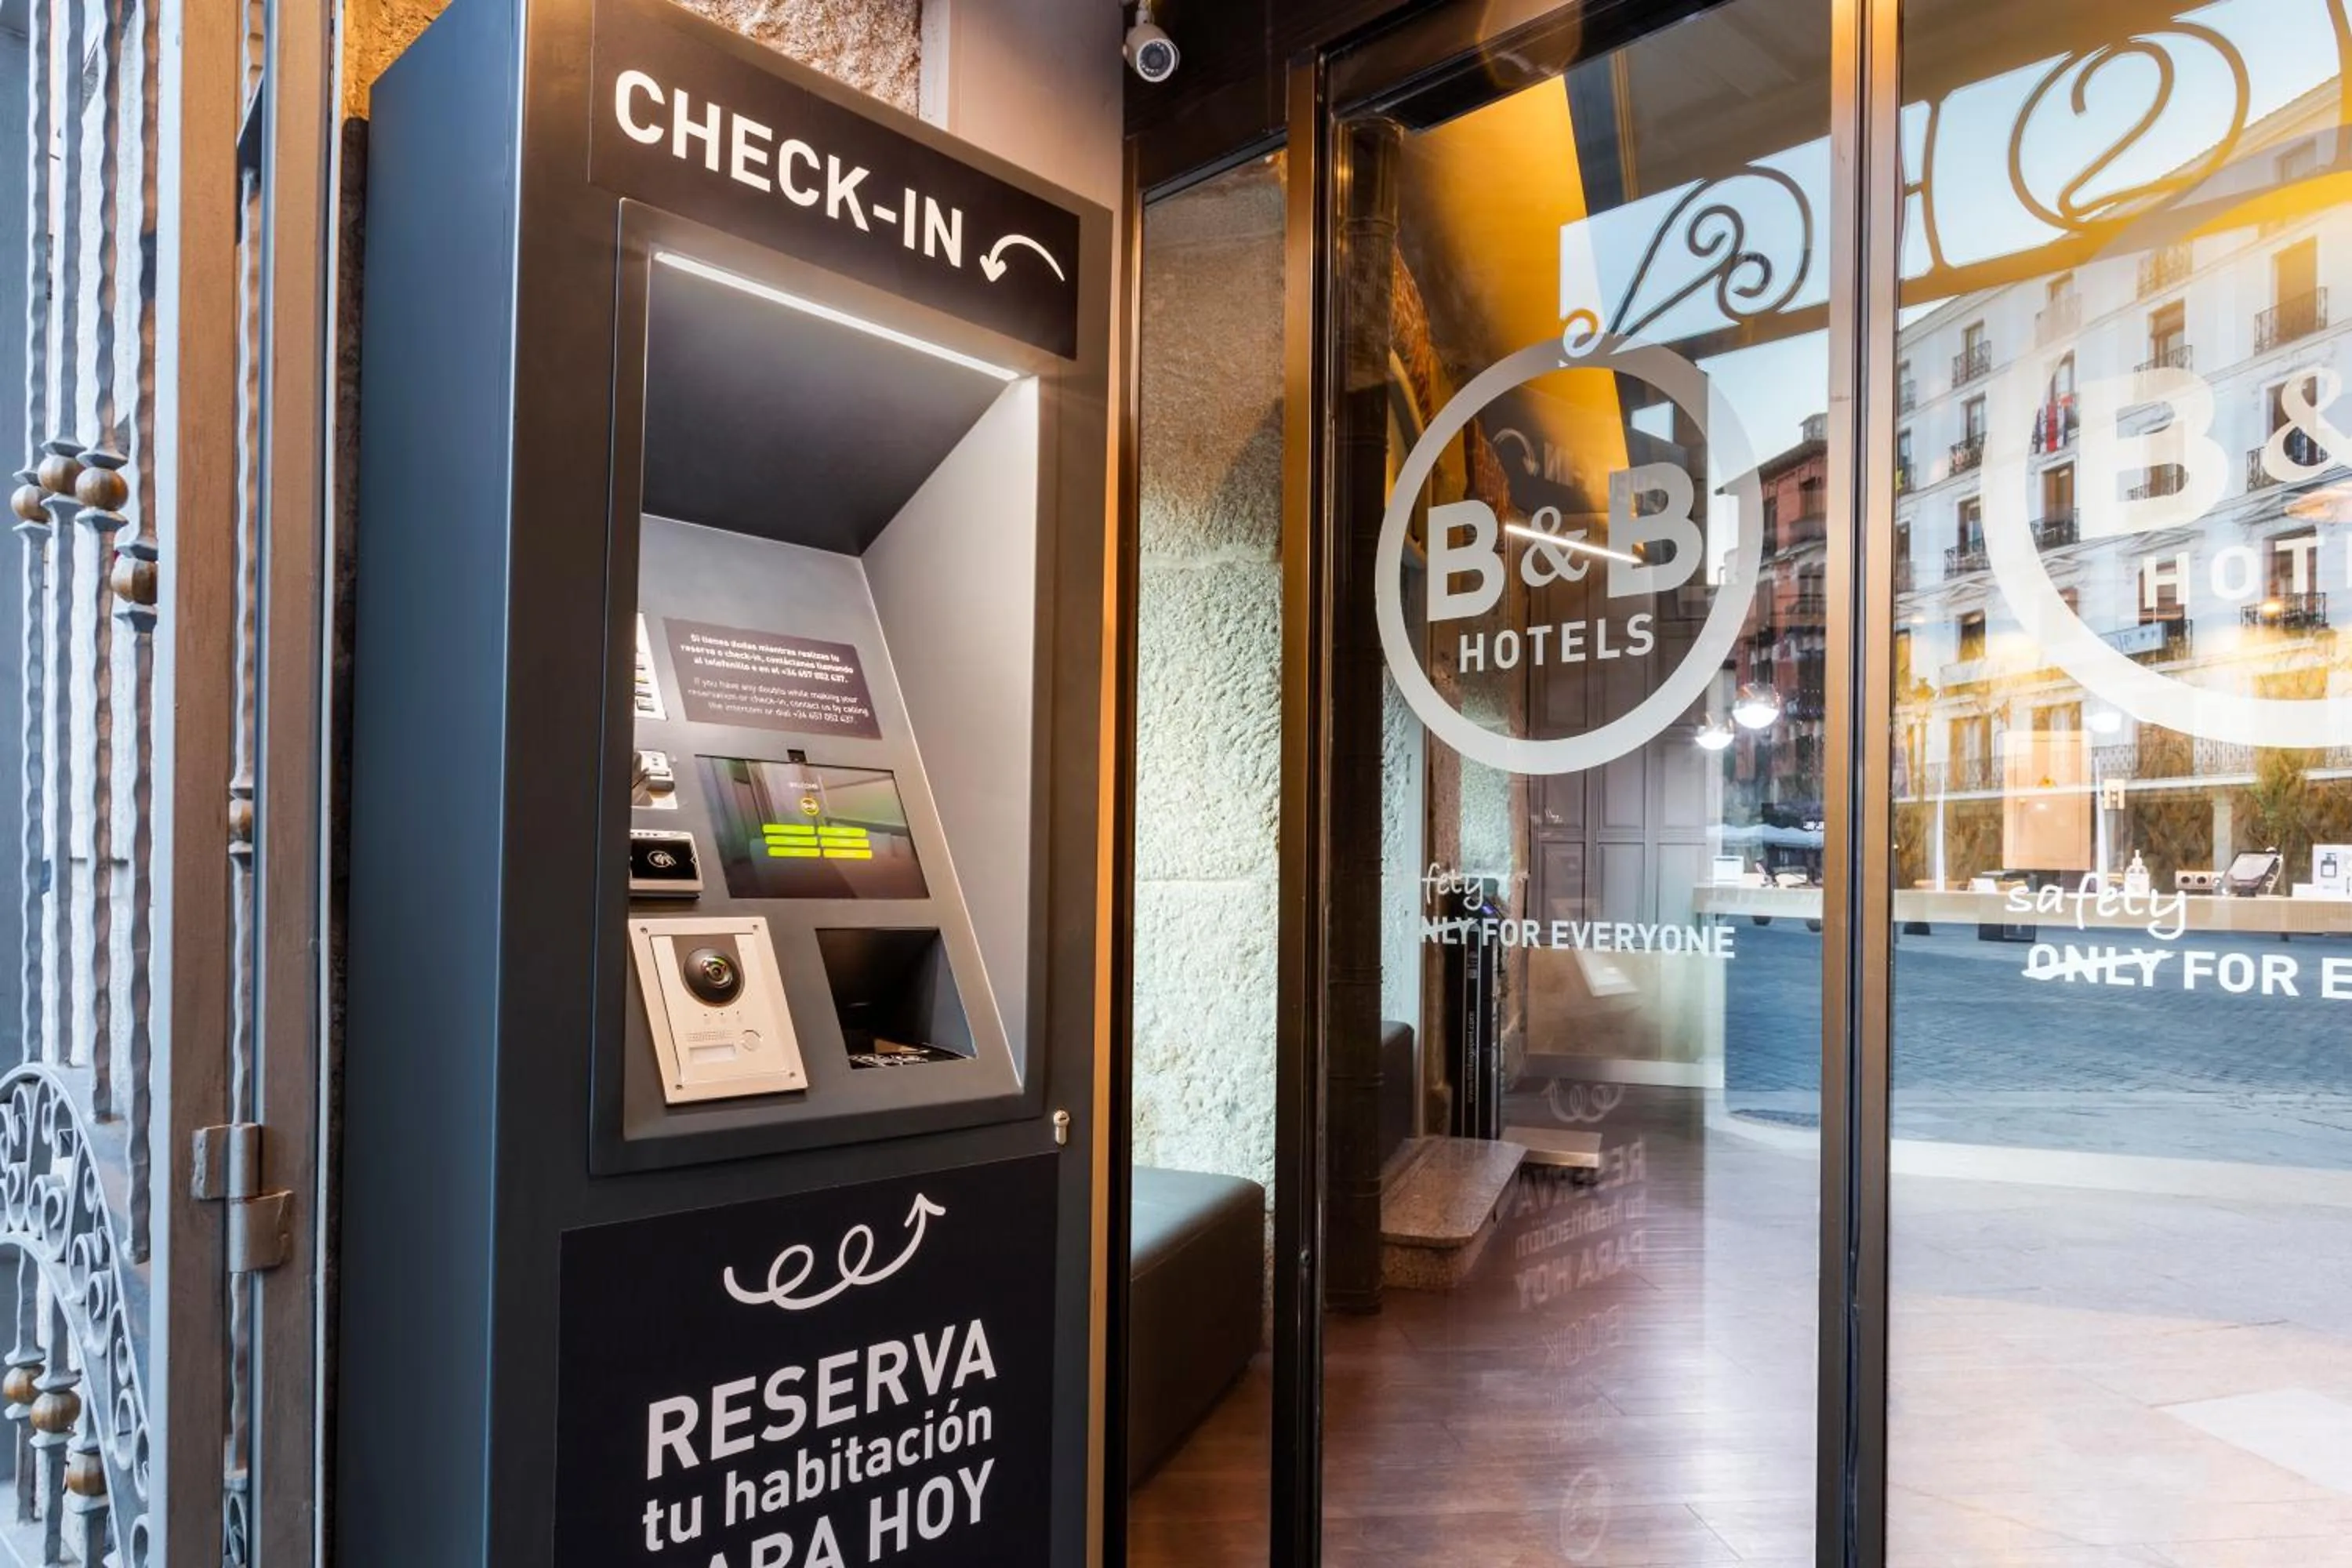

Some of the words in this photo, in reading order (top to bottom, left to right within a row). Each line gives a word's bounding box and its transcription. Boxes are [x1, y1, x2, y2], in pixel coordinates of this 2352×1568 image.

[615, 69, 963, 269] CHECK-IN
[1427, 461, 1704, 622] B&B
[2143, 534, 2352, 609] HOT
[1459, 613, 1655, 674] HOTELS
[1483, 919, 1541, 950] FOR
[1552, 919, 1735, 959] EVERYONE
[2005, 873, 2187, 940] safety
[2022, 943, 2176, 988] ONLY
[2183, 950, 2300, 997] FOR
[646, 1318, 997, 1481] RESERVA
[642, 1494, 702, 1552] tu
[725, 1398, 993, 1526] habitación
[868, 1458, 995, 1563] HOY
